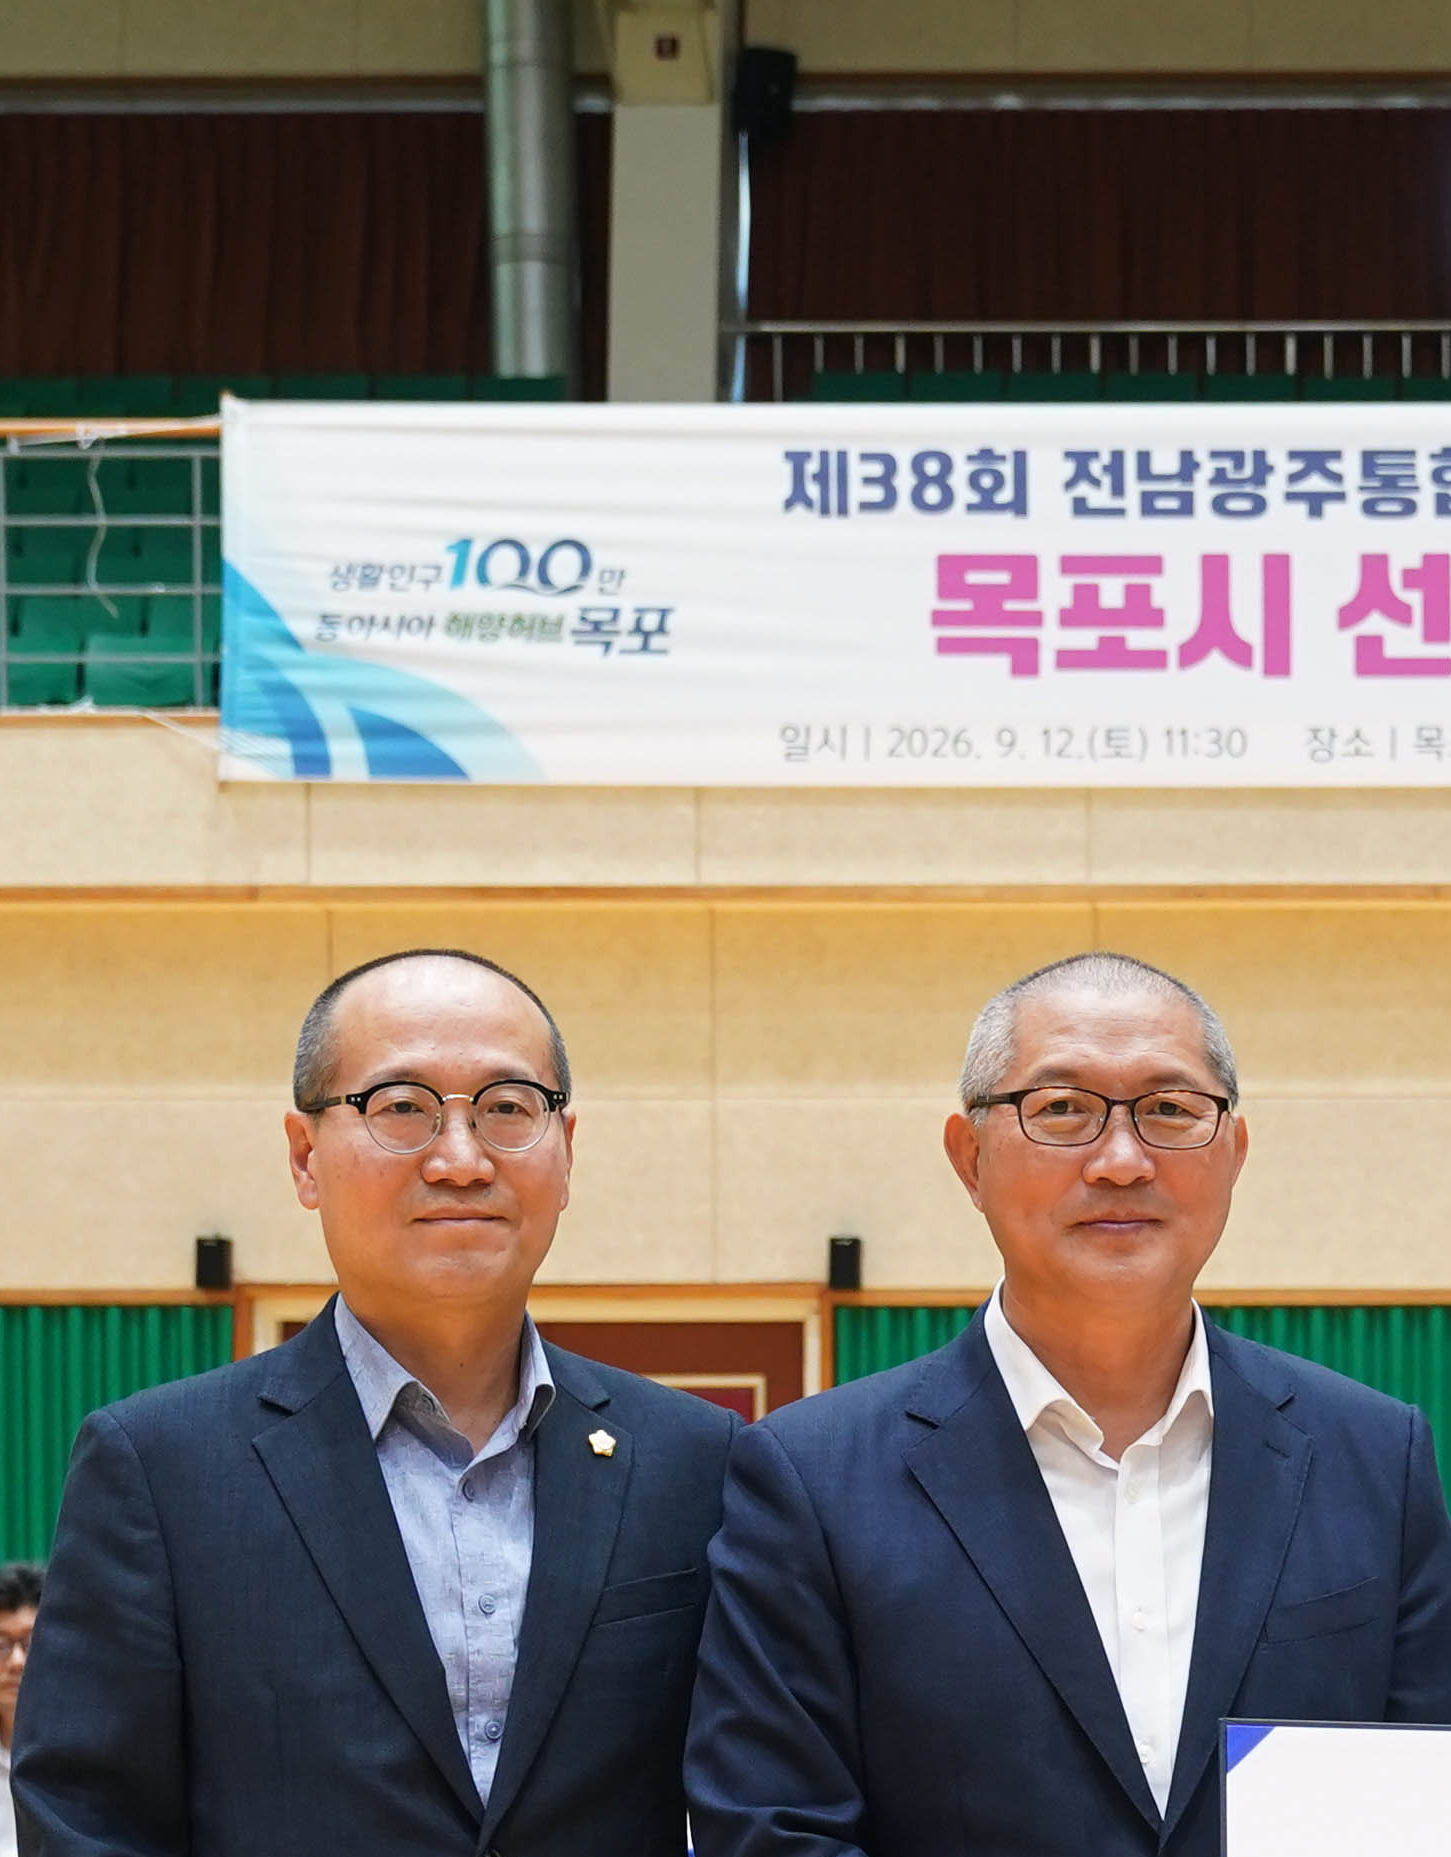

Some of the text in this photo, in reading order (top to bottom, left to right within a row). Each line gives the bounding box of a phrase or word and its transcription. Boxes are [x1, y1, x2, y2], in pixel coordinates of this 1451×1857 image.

[783, 447, 1029, 518] 제38회
[315, 605, 676, 657] 동아시아 해양허브 목포
[931, 553, 1292, 679] 목포시
[779, 724, 847, 763] 일시
[887, 726, 982, 760] 2026.
[995, 726, 1027, 760] 9.
[1164, 726, 1248, 760] 11:30
[1304, 724, 1377, 763] 장소
